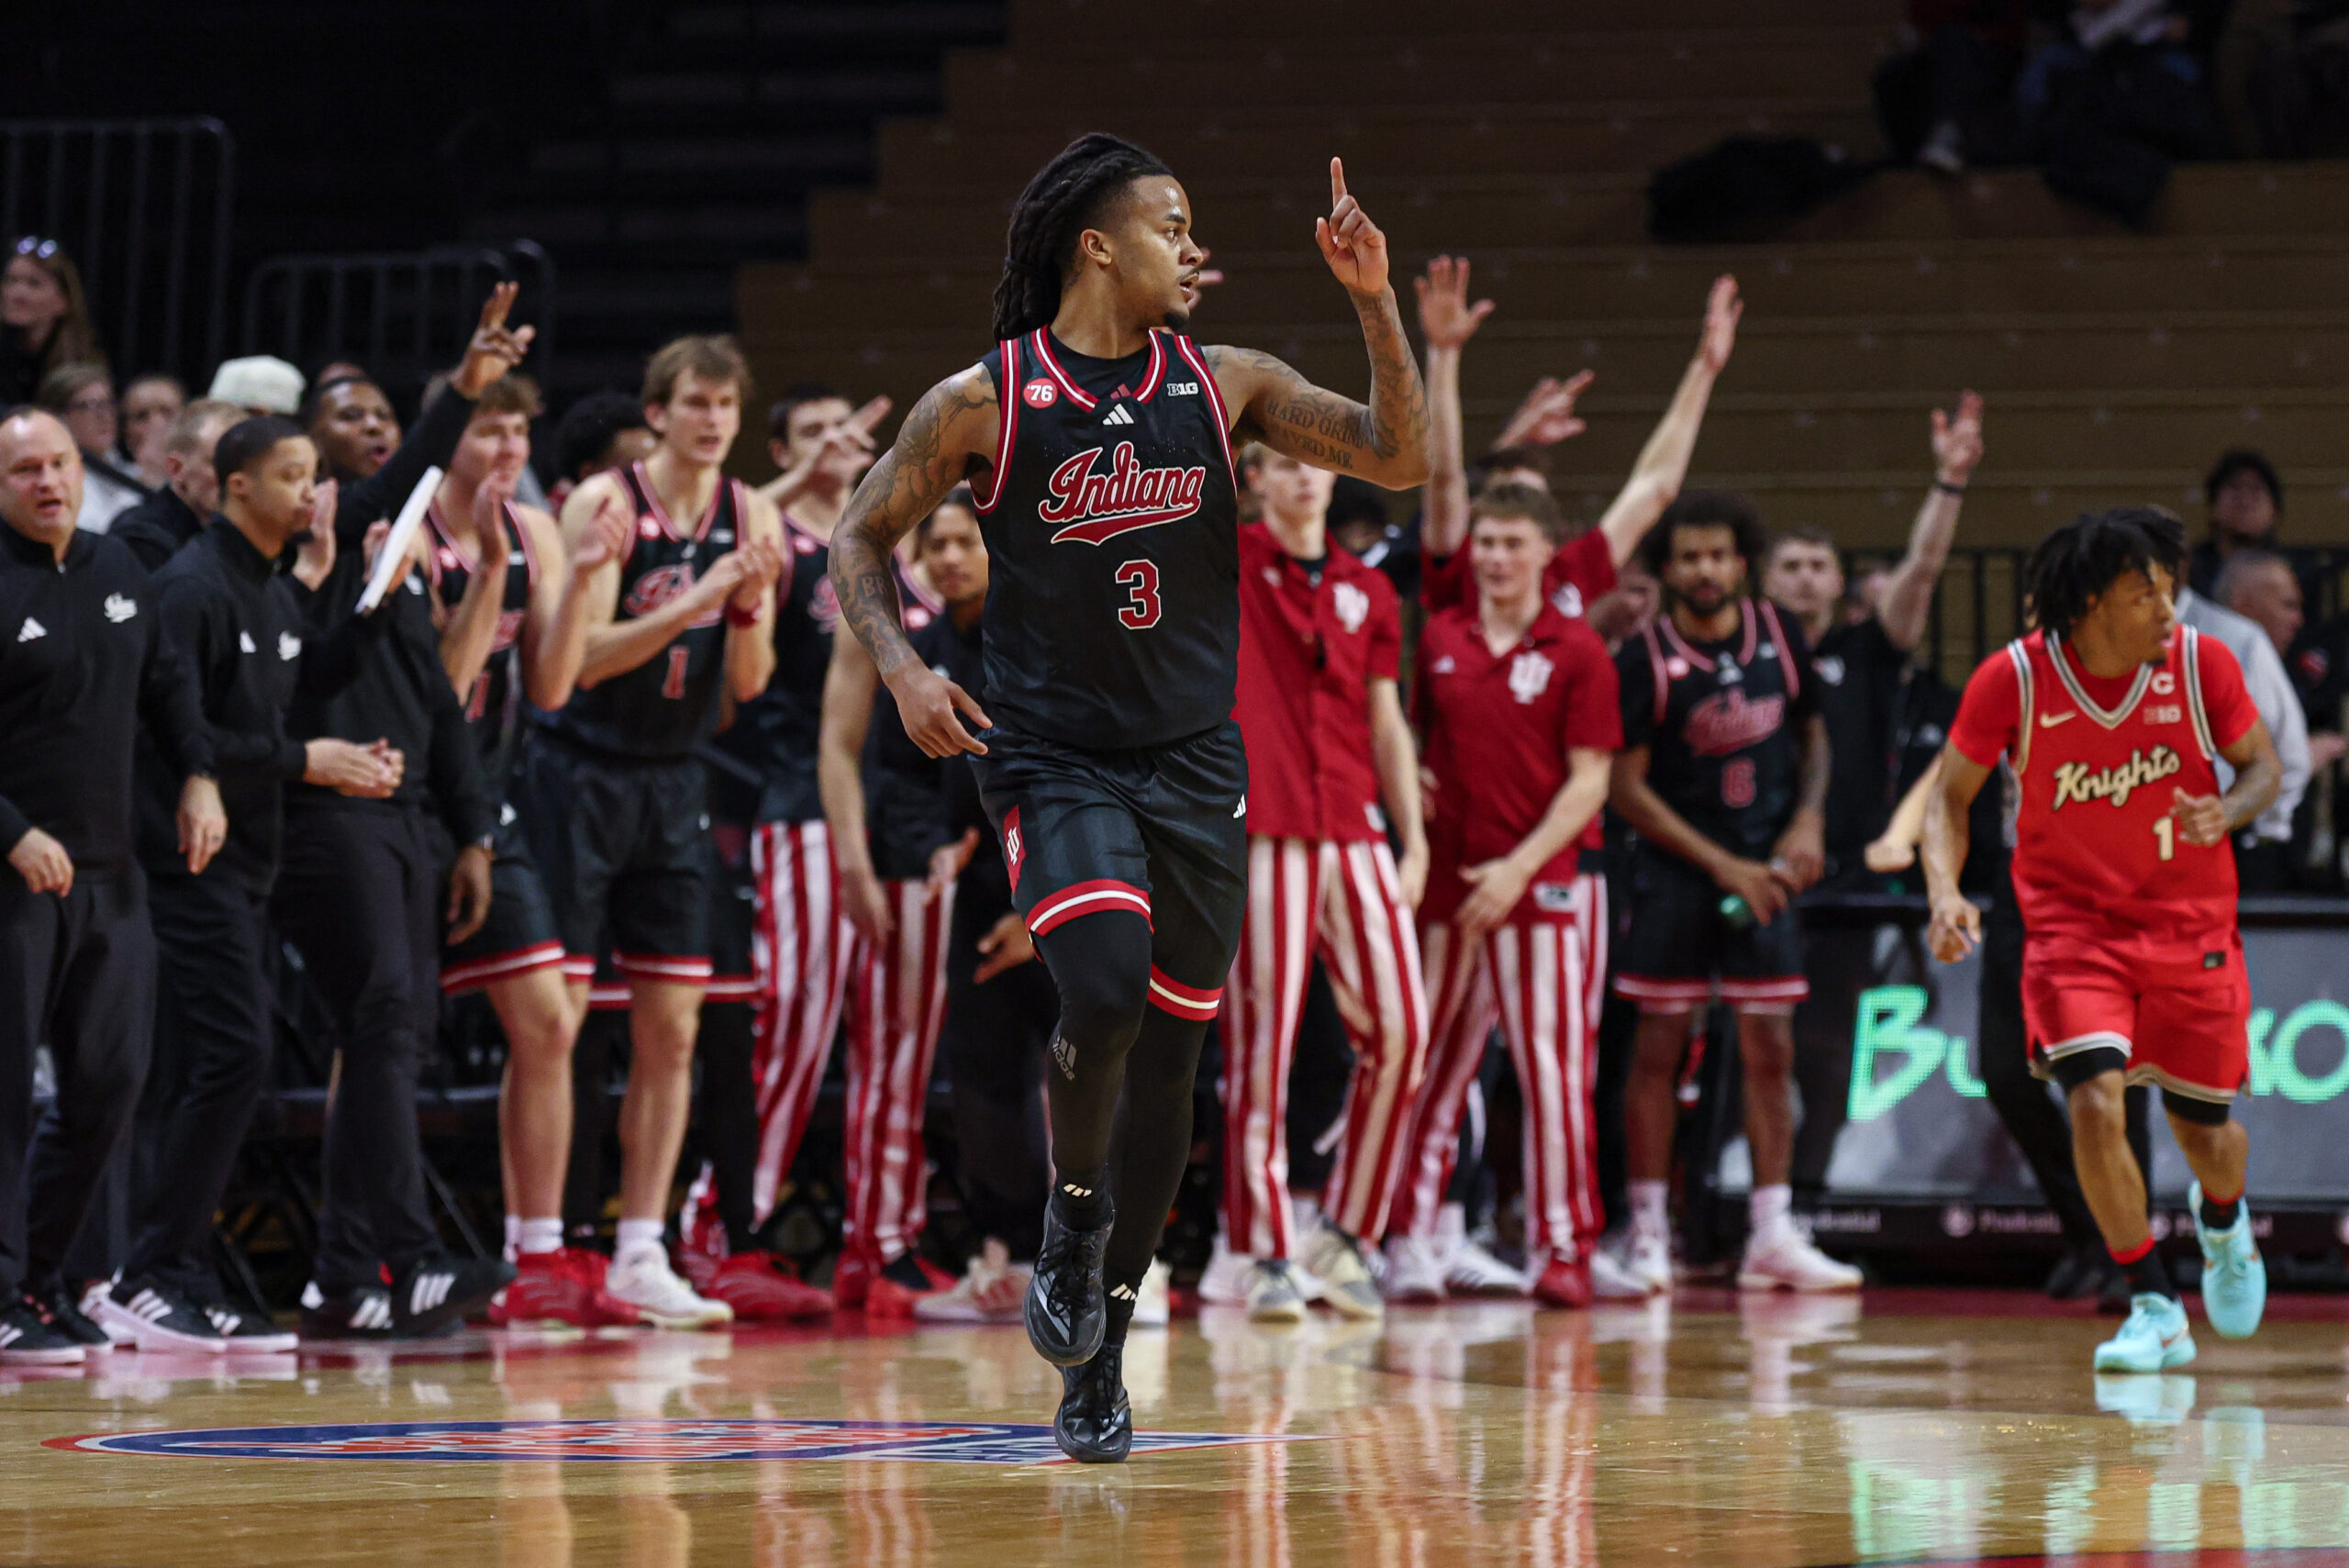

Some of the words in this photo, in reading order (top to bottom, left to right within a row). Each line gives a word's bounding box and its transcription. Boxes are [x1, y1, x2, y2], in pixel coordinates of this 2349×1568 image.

[1039, 441, 1206, 524] Indiana
[1115, 559, 1162, 630] 3
[662, 645, 690, 701] 1
[2052, 743, 2182, 812] Knights
[2153, 816, 2175, 862] 1
